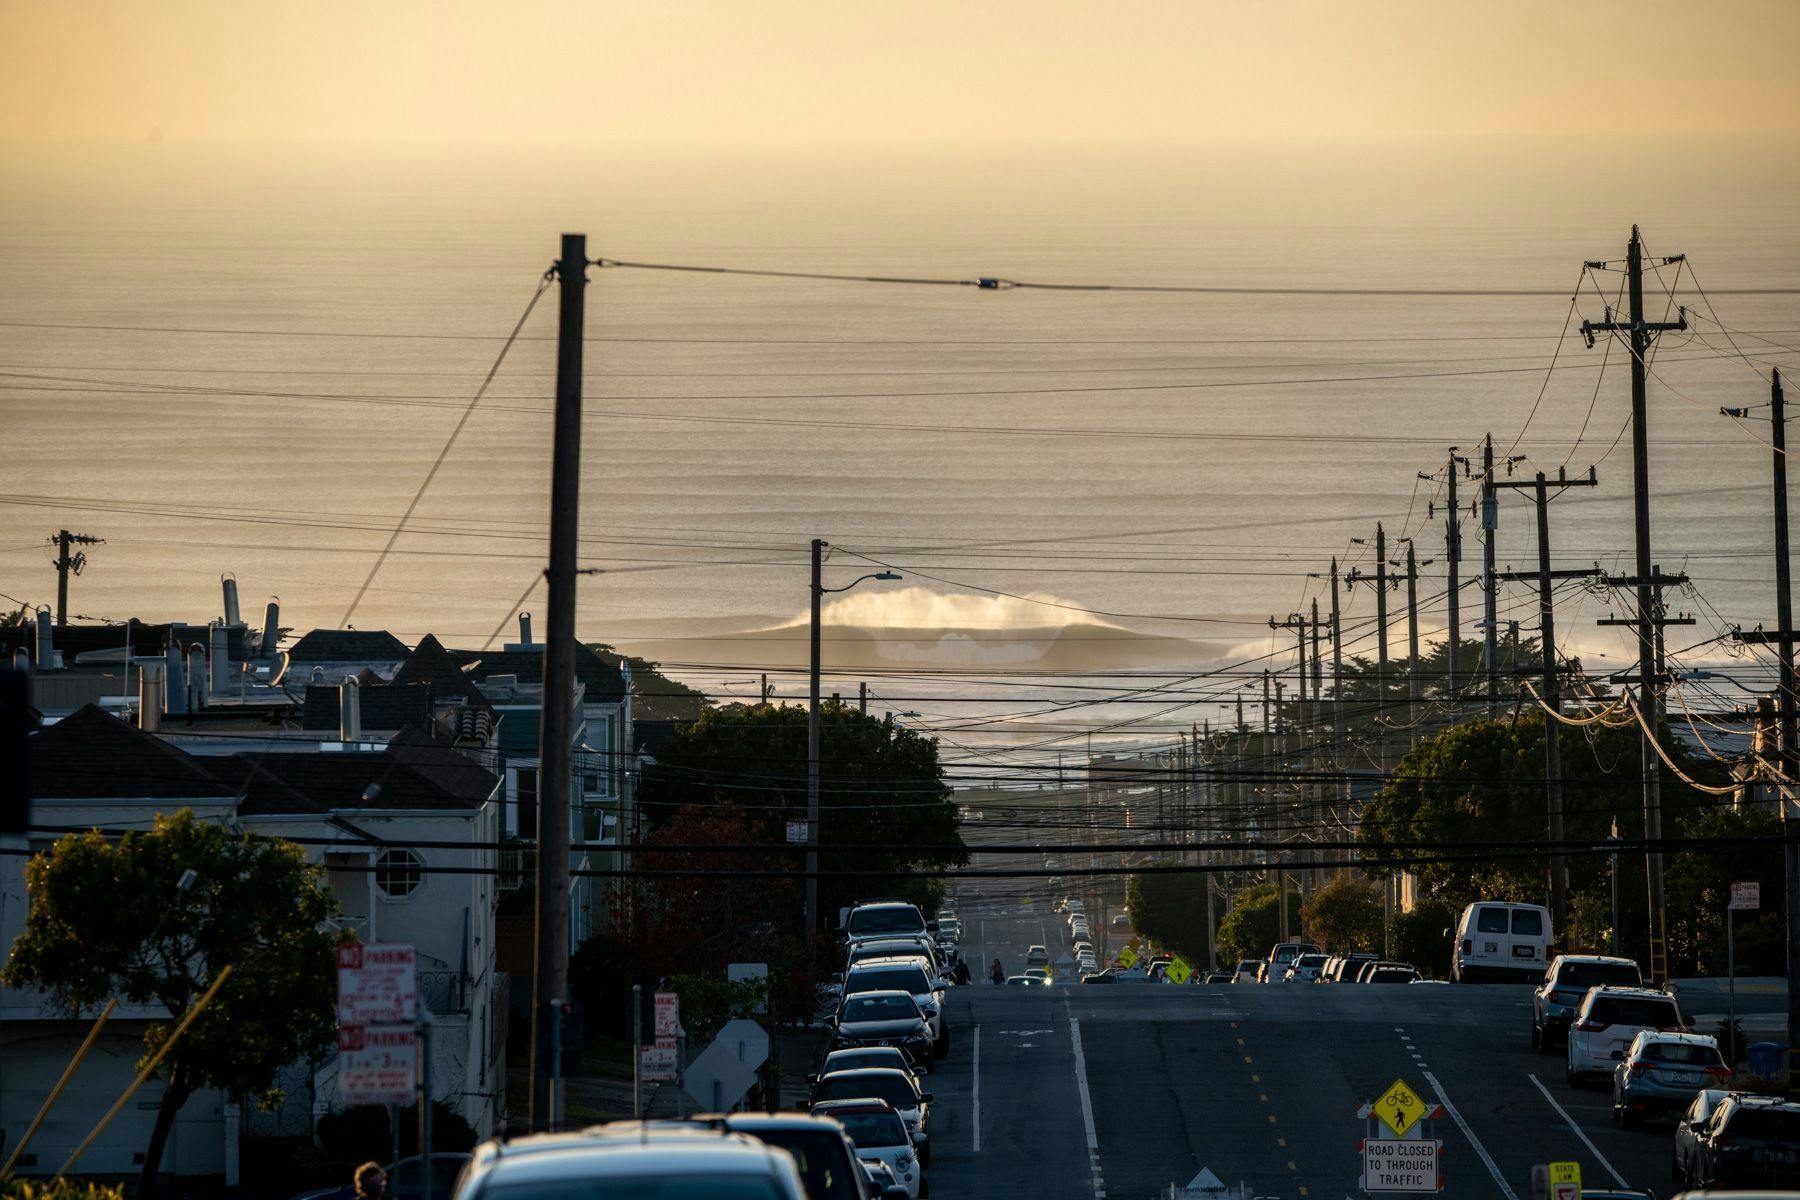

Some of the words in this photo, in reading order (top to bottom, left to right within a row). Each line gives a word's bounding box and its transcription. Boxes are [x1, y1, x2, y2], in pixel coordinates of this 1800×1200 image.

[339, 947, 362, 965] NO
[366, 950, 414, 964] PARKING
[340, 1029, 362, 1048] NO
[366, 1031, 416, 1046] PARKING
[1368, 1145, 1394, 1156] ROAD
[1398, 1145, 1434, 1156] CLOSED
[1369, 1160, 1381, 1170] TO
[1387, 1160, 1433, 1171] THROUGH
[1554, 1165, 1576, 1173] STATE
[1380, 1174, 1424, 1185] TRAFFIC
